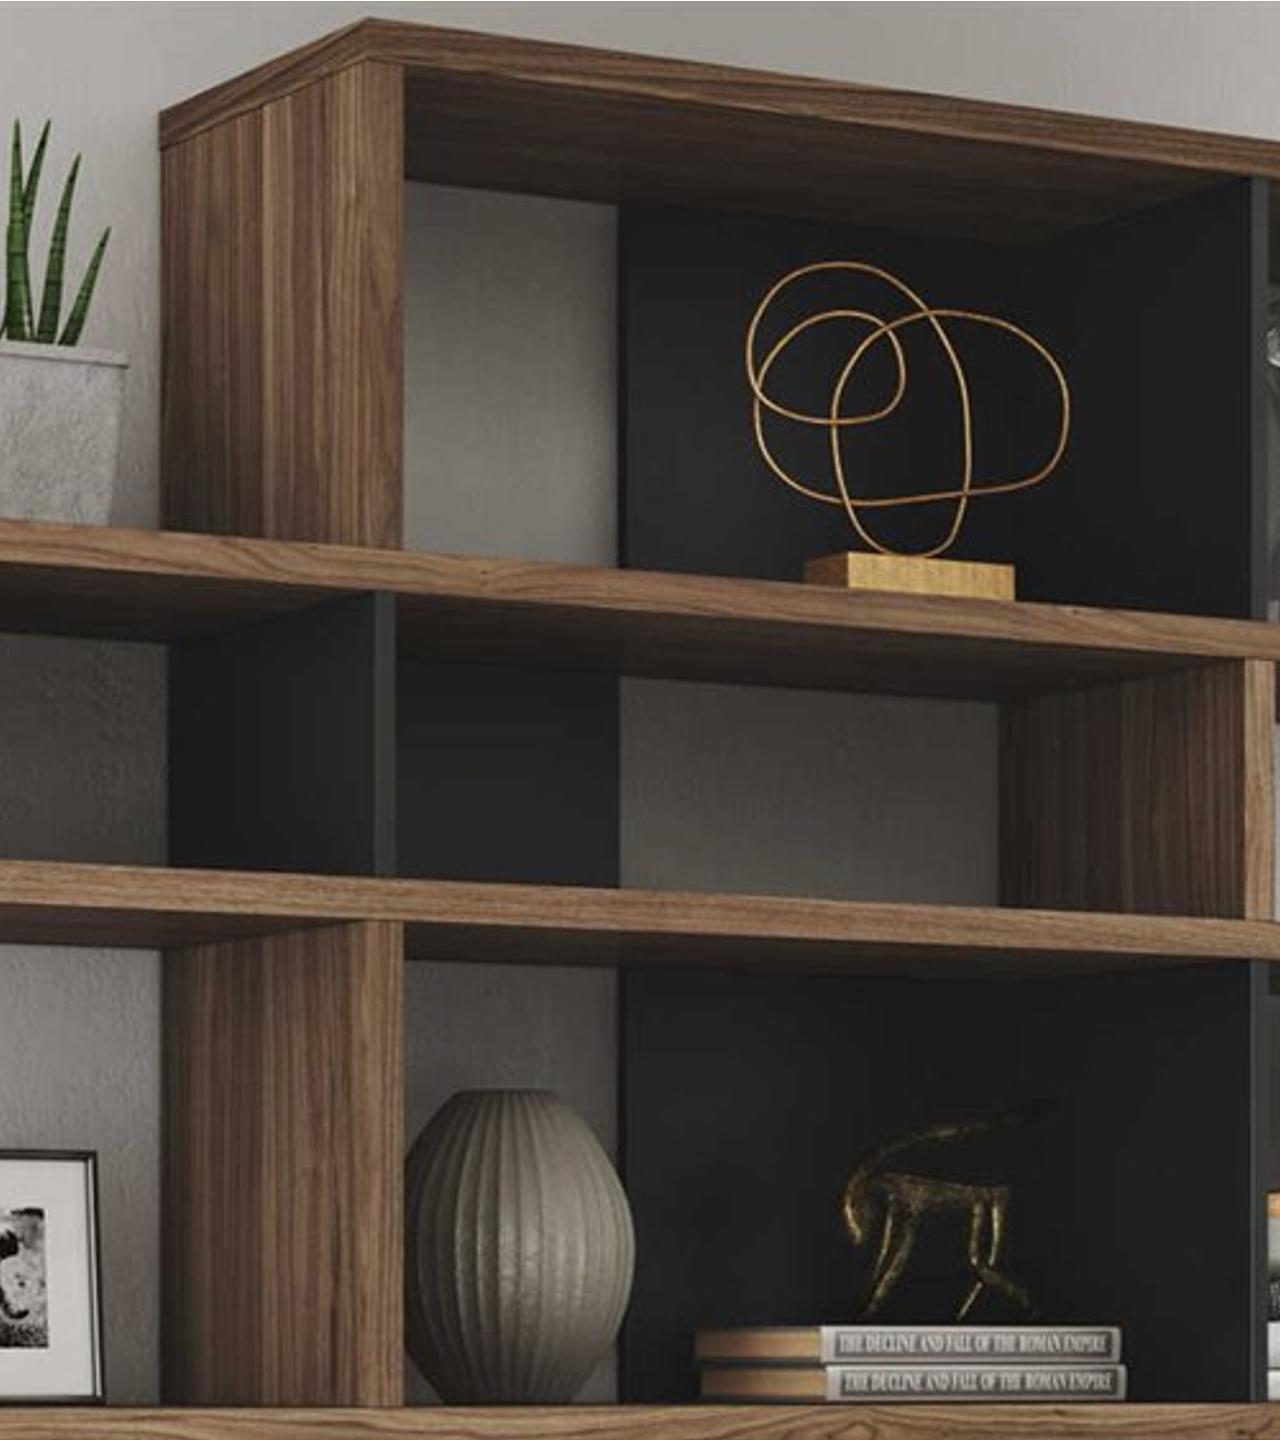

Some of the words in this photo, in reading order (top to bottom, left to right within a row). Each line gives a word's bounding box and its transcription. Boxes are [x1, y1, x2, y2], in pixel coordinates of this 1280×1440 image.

[838, 1333, 858, 1353] THE
[864, 1333, 917, 1353] DECLINE
[920, 1333, 944, 1353] AND
[946, 1333, 971, 1353] FALL
[975, 1333, 991, 1353] OF
[993, 1333, 1017, 1353] THE
[1019, 1333, 1065, 1353] ROMAN
[1067, 1333, 1109, 1353] EMPIRE
[844, 1372, 868, 1392] THE
[870, 1372, 923, 1392] DECLINE
[925, 1372, 951, 1392] AND
[952, 1372, 978, 1392] FALL
[980, 1372, 998, 1392] OF
[999, 1372, 1022, 1392] THE
[1025, 1372, 1067, 1392] ROMAN
[1069, 1372, 1113, 1392] EMPIRE
